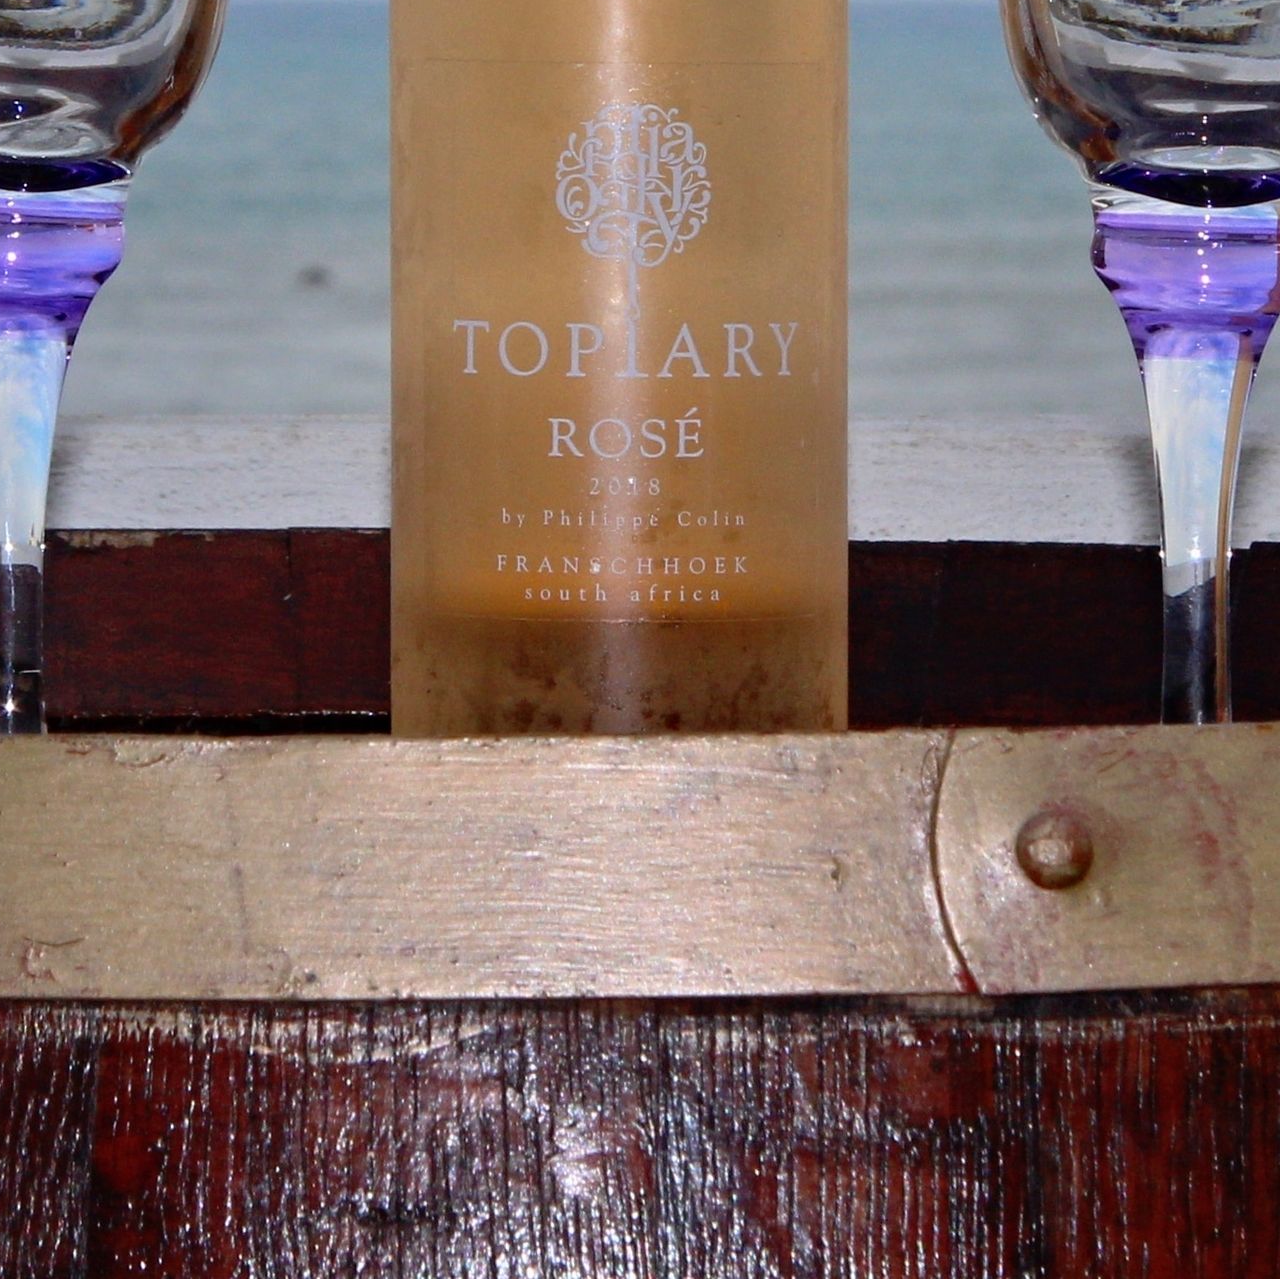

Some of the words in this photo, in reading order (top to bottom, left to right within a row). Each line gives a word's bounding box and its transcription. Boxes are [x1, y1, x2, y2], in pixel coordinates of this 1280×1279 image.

[452, 318, 799, 378] TOPIARY
[547, 406, 705, 459] ROSÉ
[589, 477, 661, 496] 2018
[502, 507, 526, 528] by
[543, 509, 659, 531] Philippe
[677, 510, 746, 527] Colin
[496, 554, 748, 575] FRANSCHHOEK
[524, 583, 608, 602] south
[629, 583, 721, 602] africa
